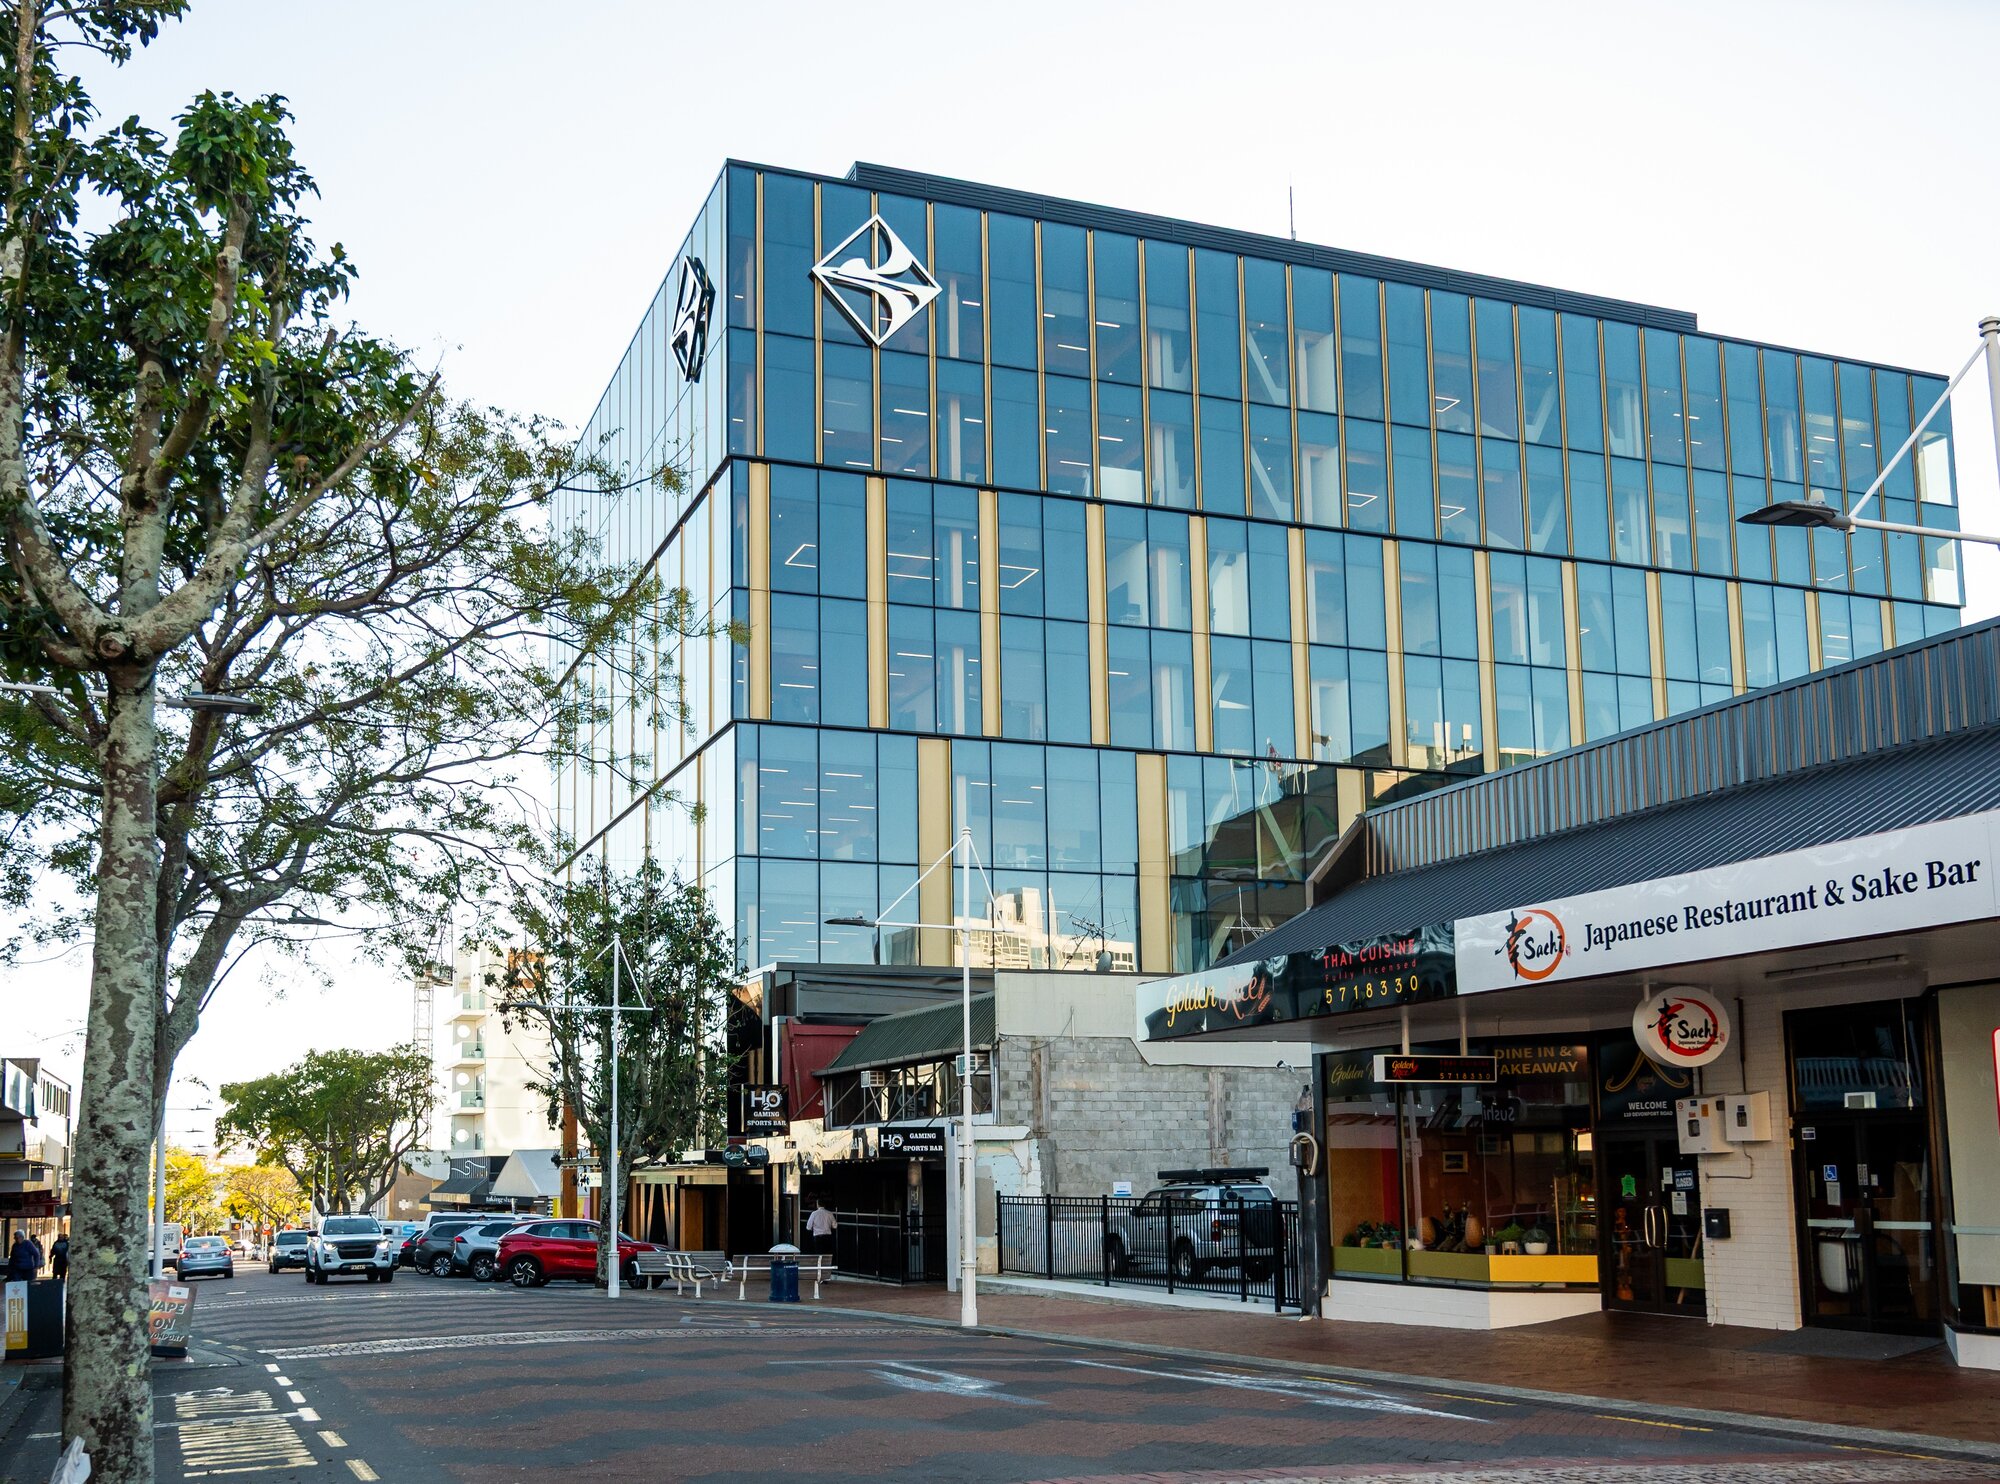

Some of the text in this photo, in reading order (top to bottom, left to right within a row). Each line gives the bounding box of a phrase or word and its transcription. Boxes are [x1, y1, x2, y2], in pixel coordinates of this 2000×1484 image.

[1583, 859, 1981, 952] Japanese Restaurant & Sake Bar
[1323, 938, 1416, 970] THAI CUISINE
[1523, 930, 1563, 961] Sachi
[1325, 959, 1417, 984] Fully licensed
[1165, 979, 1217, 1029] Golden
[1676, 1018, 1719, 1040] Sachi
[1494, 1046, 1572, 1060] DINE IN &
[1330, 1063, 1365, 1087] Golden
[1392, 1060, 1415, 1074] Golden
[1496, 1061, 1578, 1076] AKEAWAY
[1628, 1100, 1668, 1111] WELCOME
[150, 1300, 187, 1315] VAPE
[153, 1317, 176, 1331] ON
